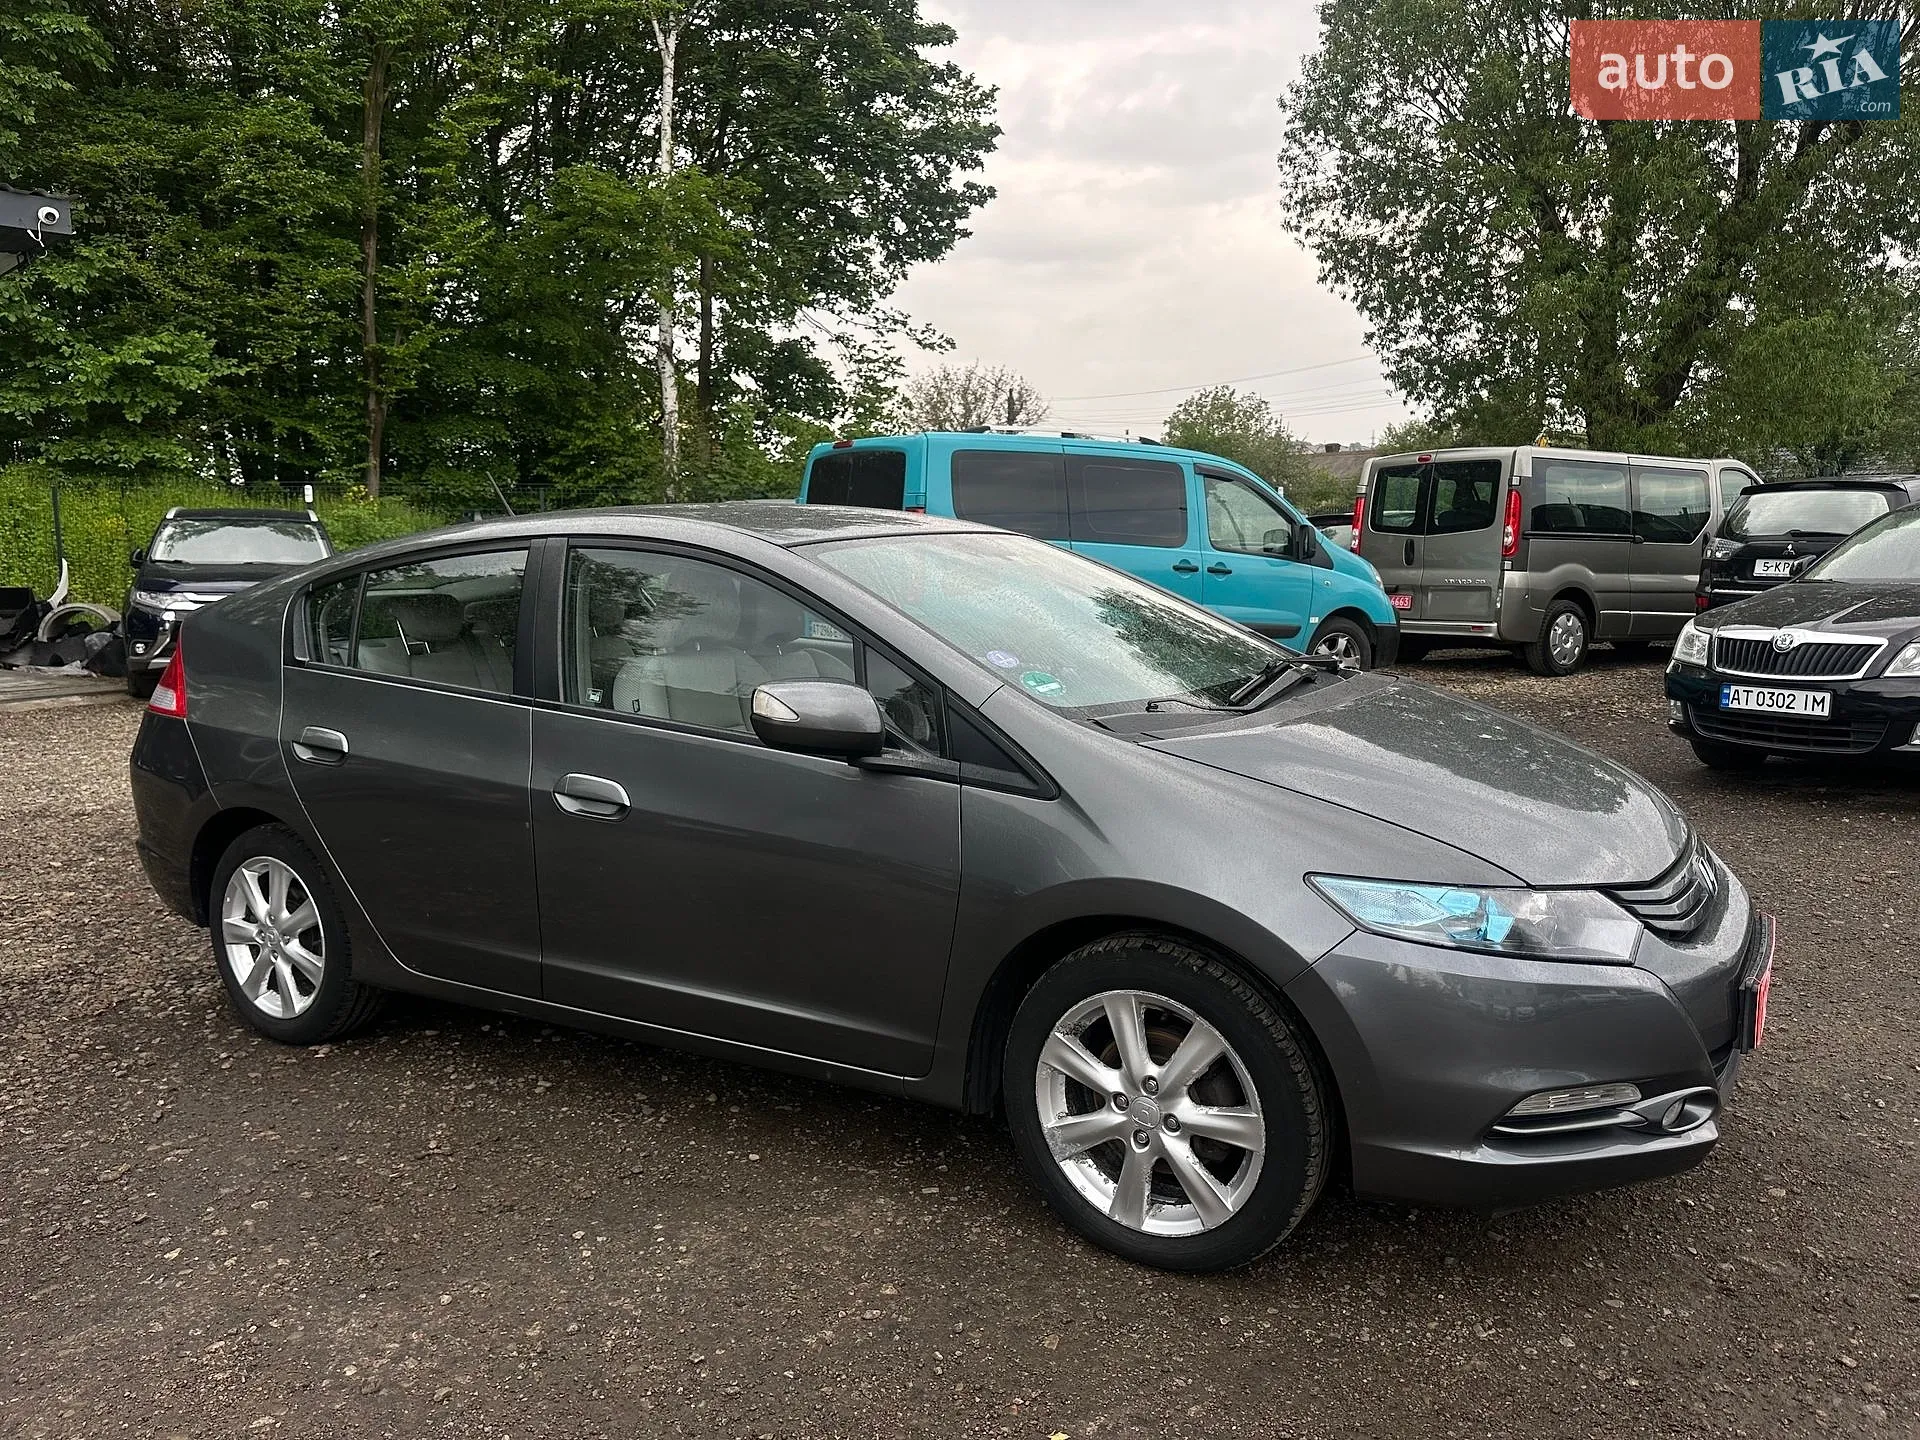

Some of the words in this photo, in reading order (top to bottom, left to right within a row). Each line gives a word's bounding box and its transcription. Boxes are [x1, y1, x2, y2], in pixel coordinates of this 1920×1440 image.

[1730, 689, 1753, 706] AT
[1756, 691, 1797, 710] 0302
[1803, 694, 1826, 713] IM
